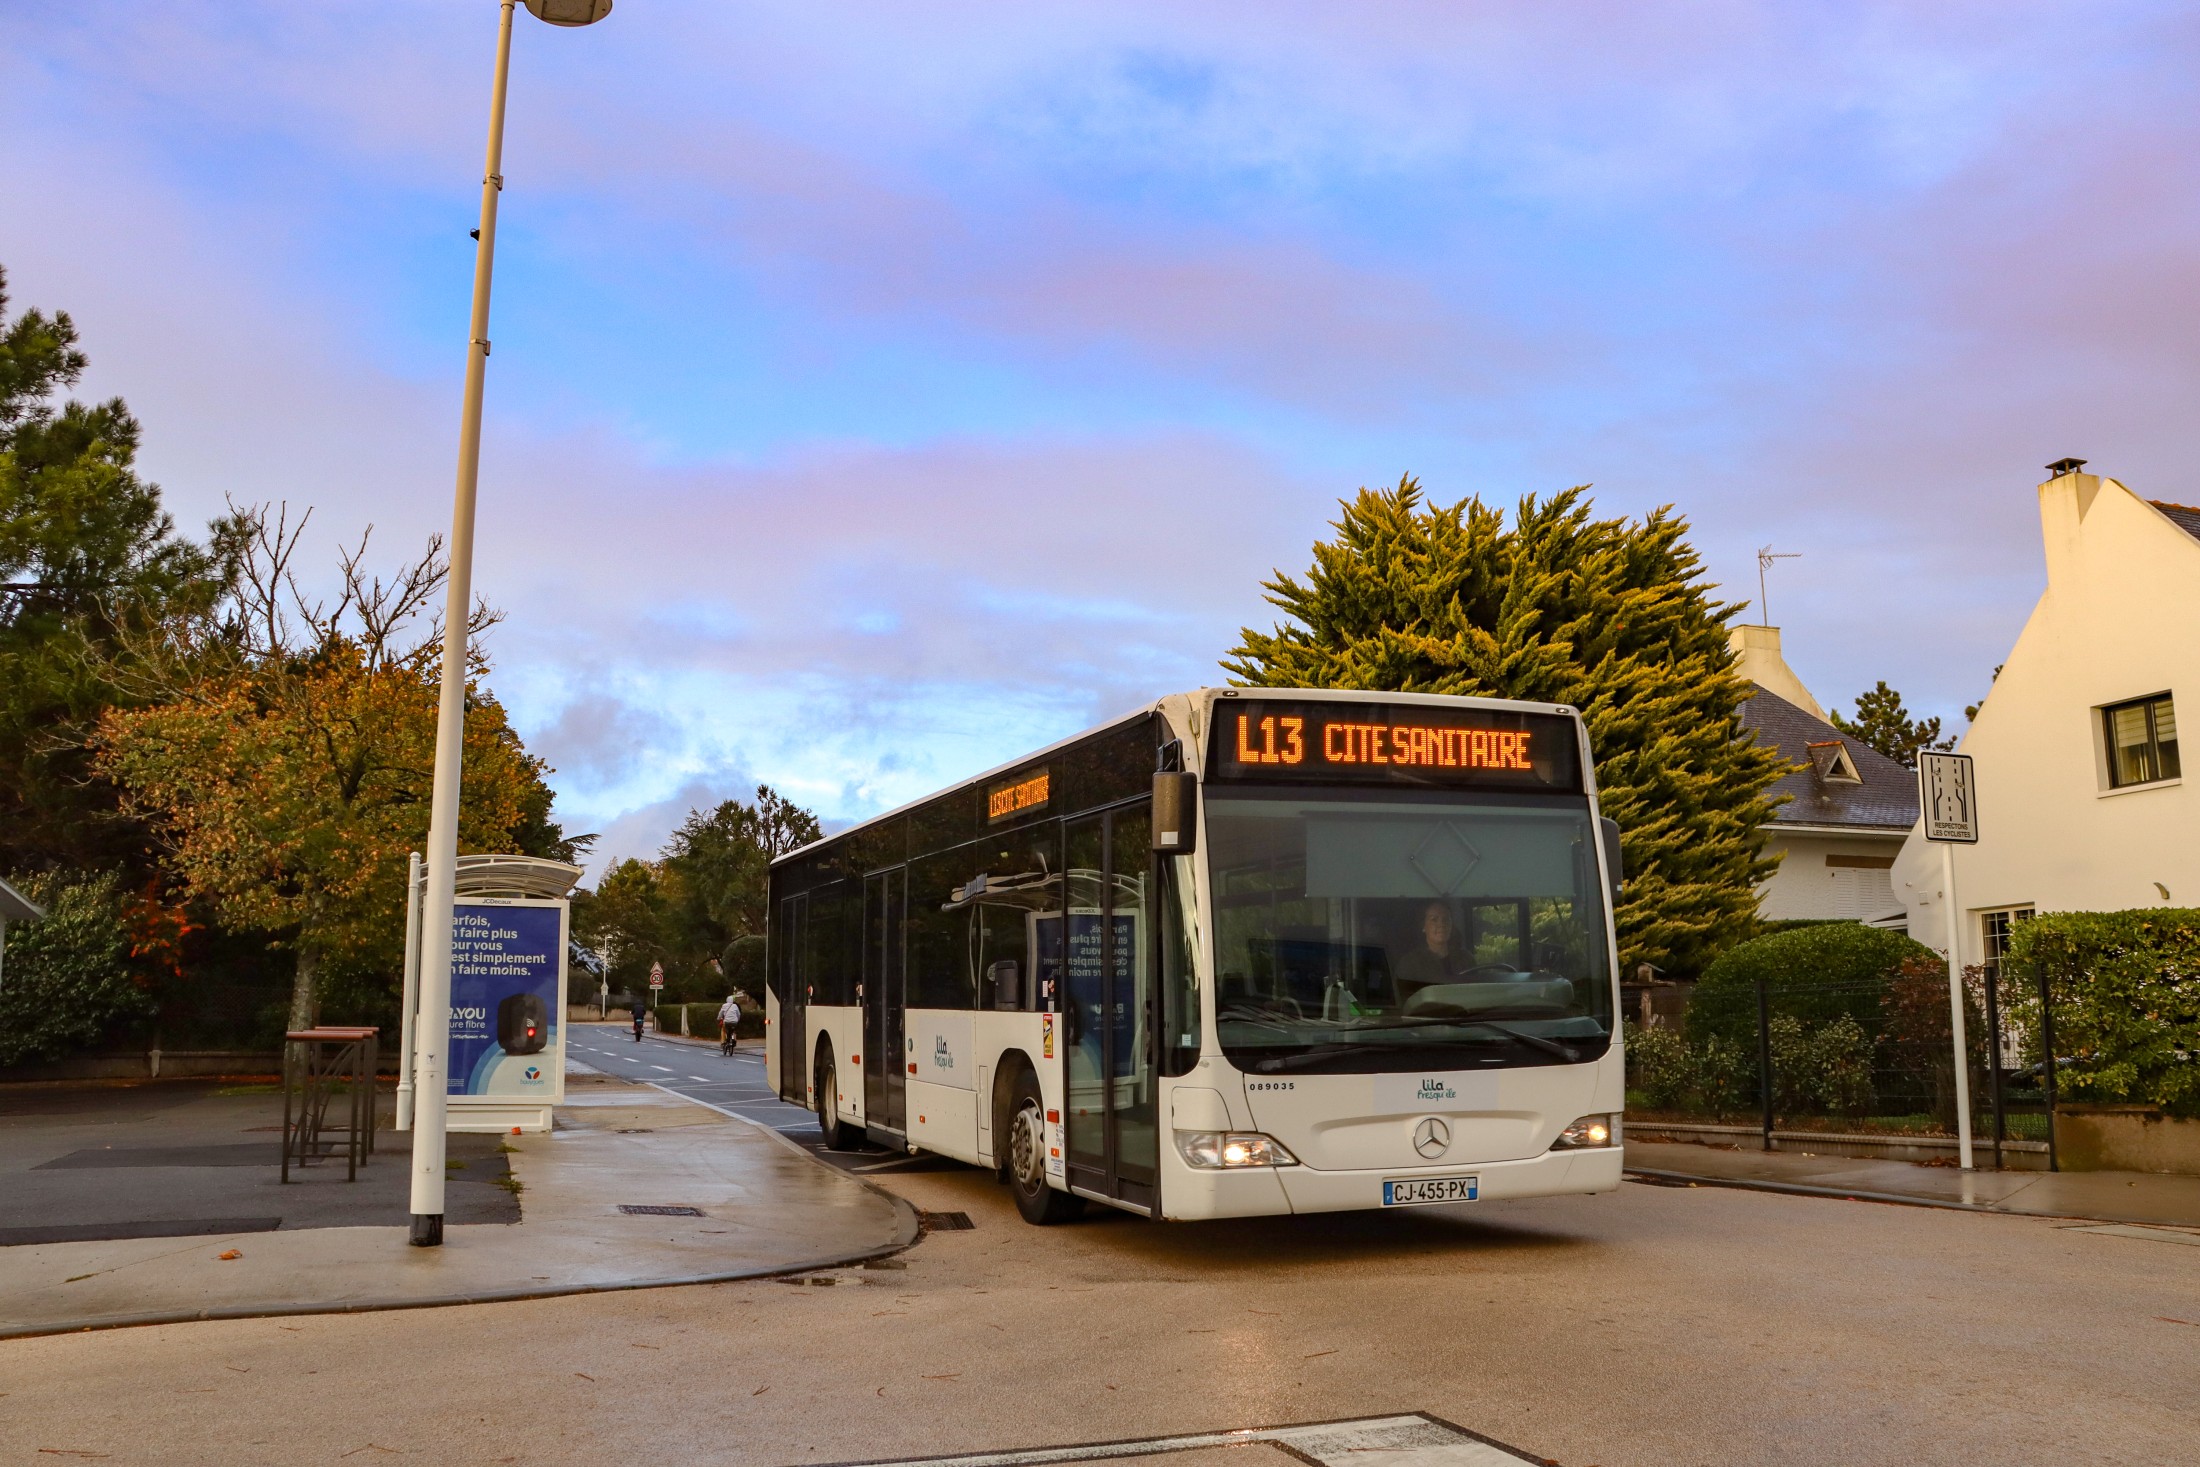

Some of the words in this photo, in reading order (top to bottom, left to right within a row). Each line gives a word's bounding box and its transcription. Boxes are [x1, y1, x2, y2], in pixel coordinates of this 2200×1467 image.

[1238, 715, 1303, 763] L13
[1934, 822, 1968, 830] RESPECTONS
[1943, 830, 1971, 838] CYCLISTES
[453, 915, 491, 928] arfois,
[460, 927, 489, 938] faire
[491, 928, 518, 941] plus
[452, 941, 472, 950] our
[473, 942, 503, 951] vous
[451, 953, 471, 963] est
[472, 952, 547, 965] simplement
[458, 964, 488, 975] faire
[490, 965, 531, 976] moins.
[449, 1021, 464, 1029] ure
[465, 1020, 486, 1029] fibre
[1394, 1181, 1467, 1201] CJ-455-PX
